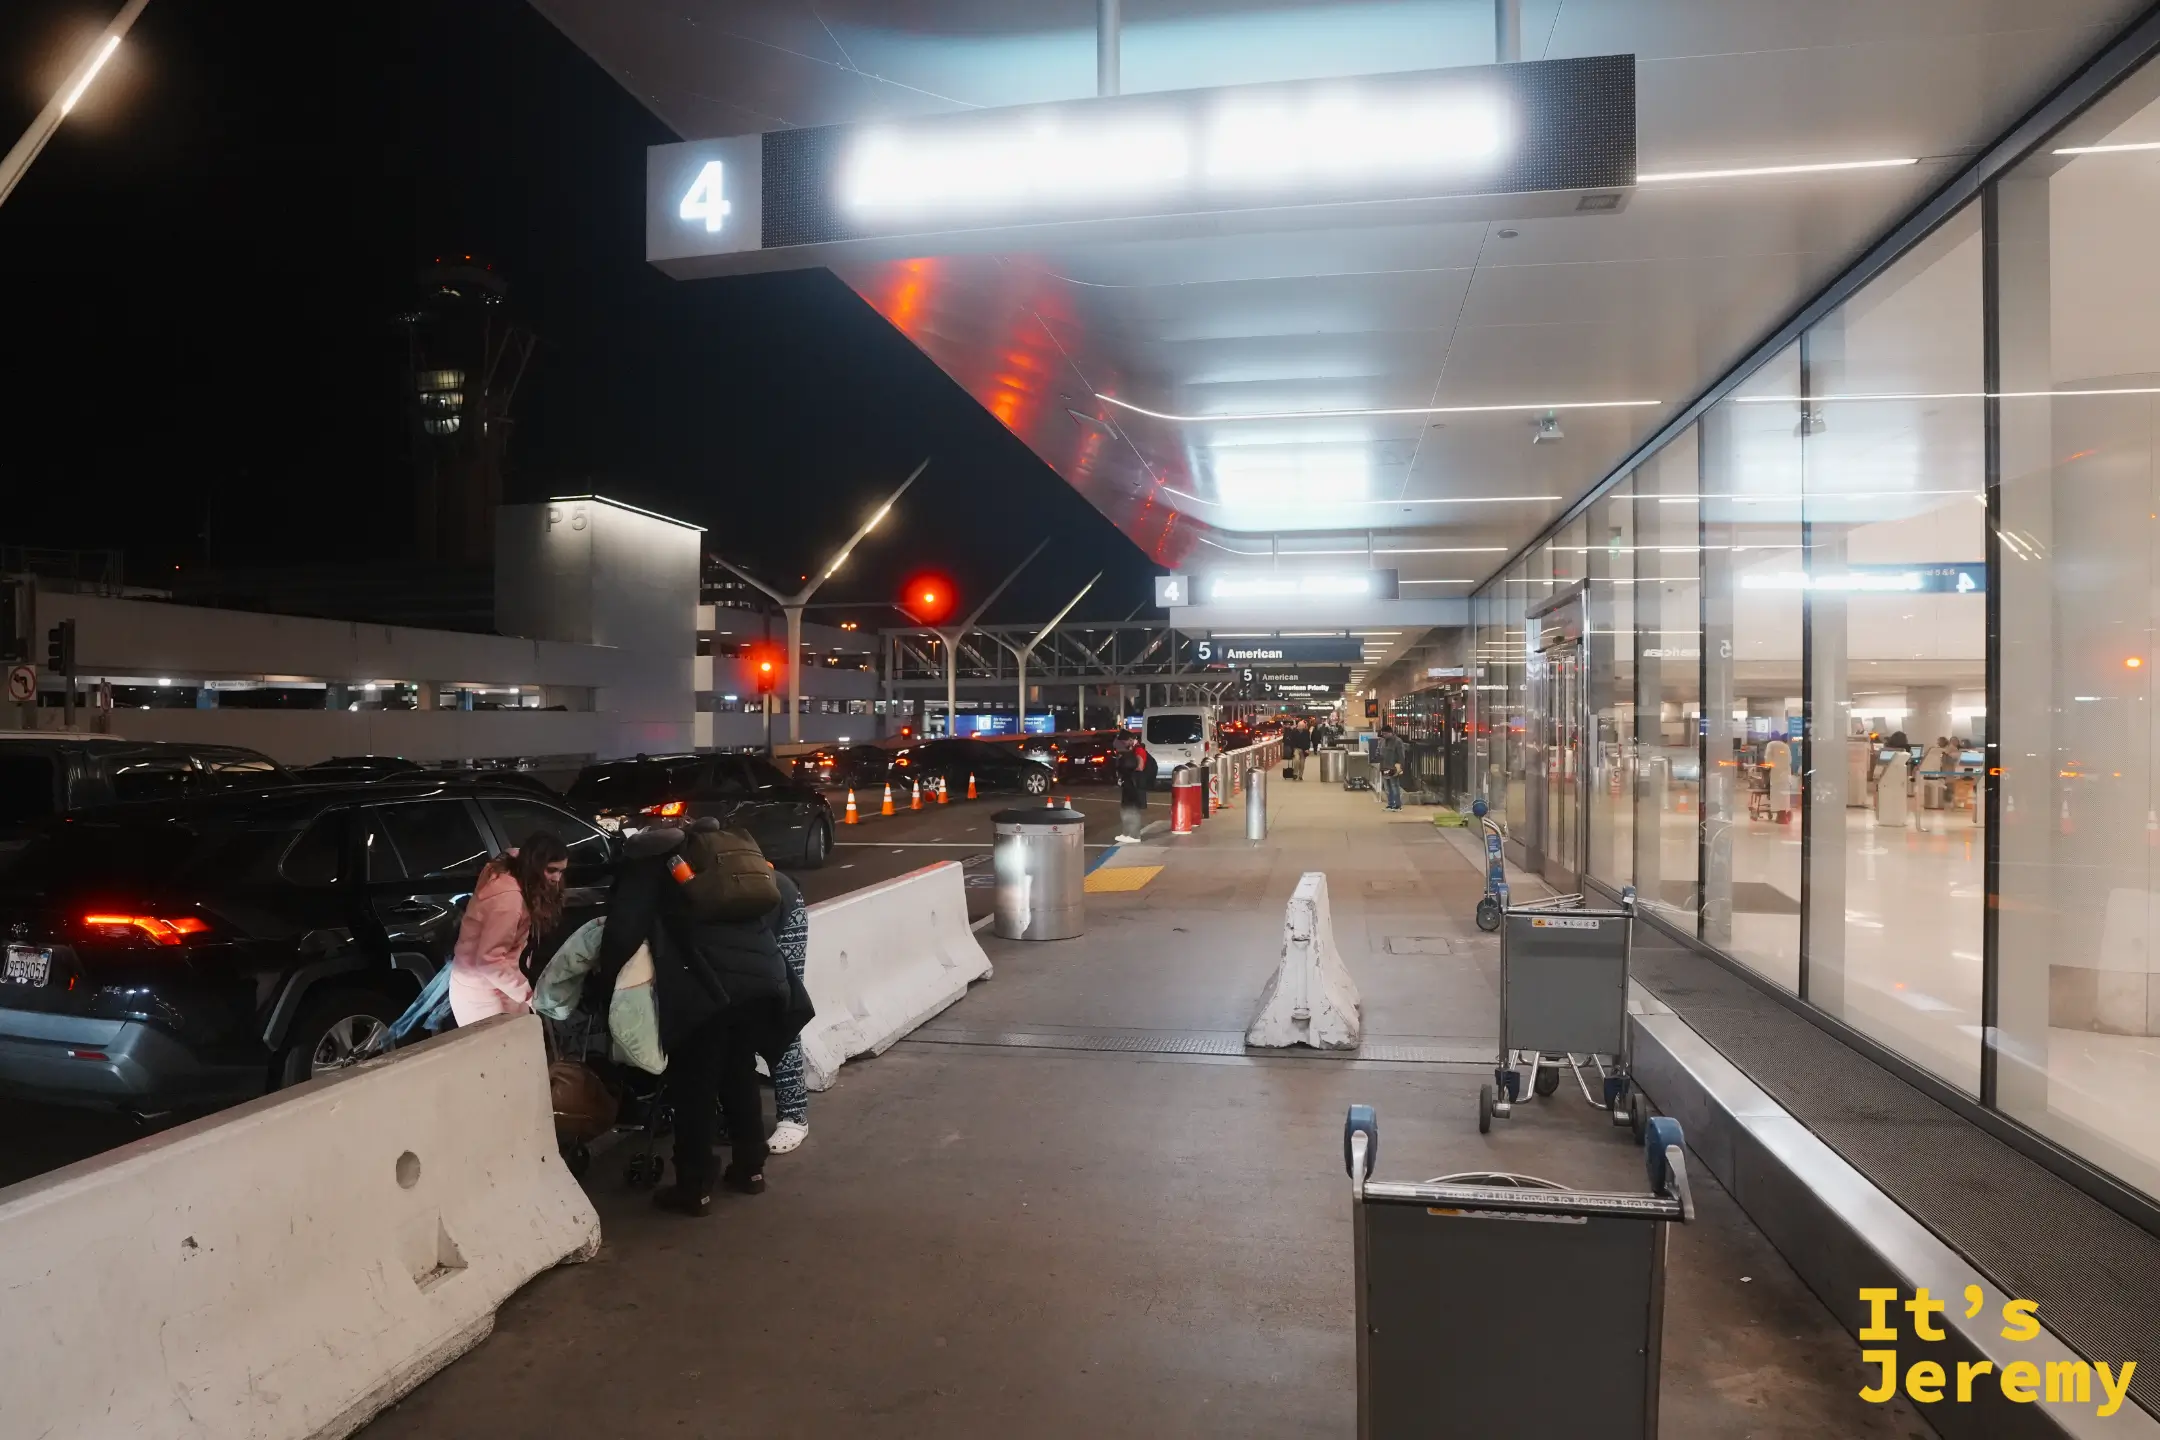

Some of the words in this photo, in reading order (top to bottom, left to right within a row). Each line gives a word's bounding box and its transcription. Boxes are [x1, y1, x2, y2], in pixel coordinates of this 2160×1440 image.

[680, 161, 731, 231] 4
[545, 507, 563, 532] P
[572, 506, 587, 531] 5
[1164, 582, 1180, 601] 4
[1198, 641, 1211, 660] 5
[1227, 648, 1283, 659] American
[1243, 669, 1253, 681] 5
[1262, 673, 1299, 681] American
[1278, 684, 1306, 692] American
[1307, 684, 1329, 692] Priority
[1492, 1191, 1511, 1201] Lift
[1513, 1193, 1554, 1204] Handle
[1557, 1196, 1570, 1205] to
[1573, 1196, 1618, 1207] Release
[1621, 1199, 1655, 1209] Brake
